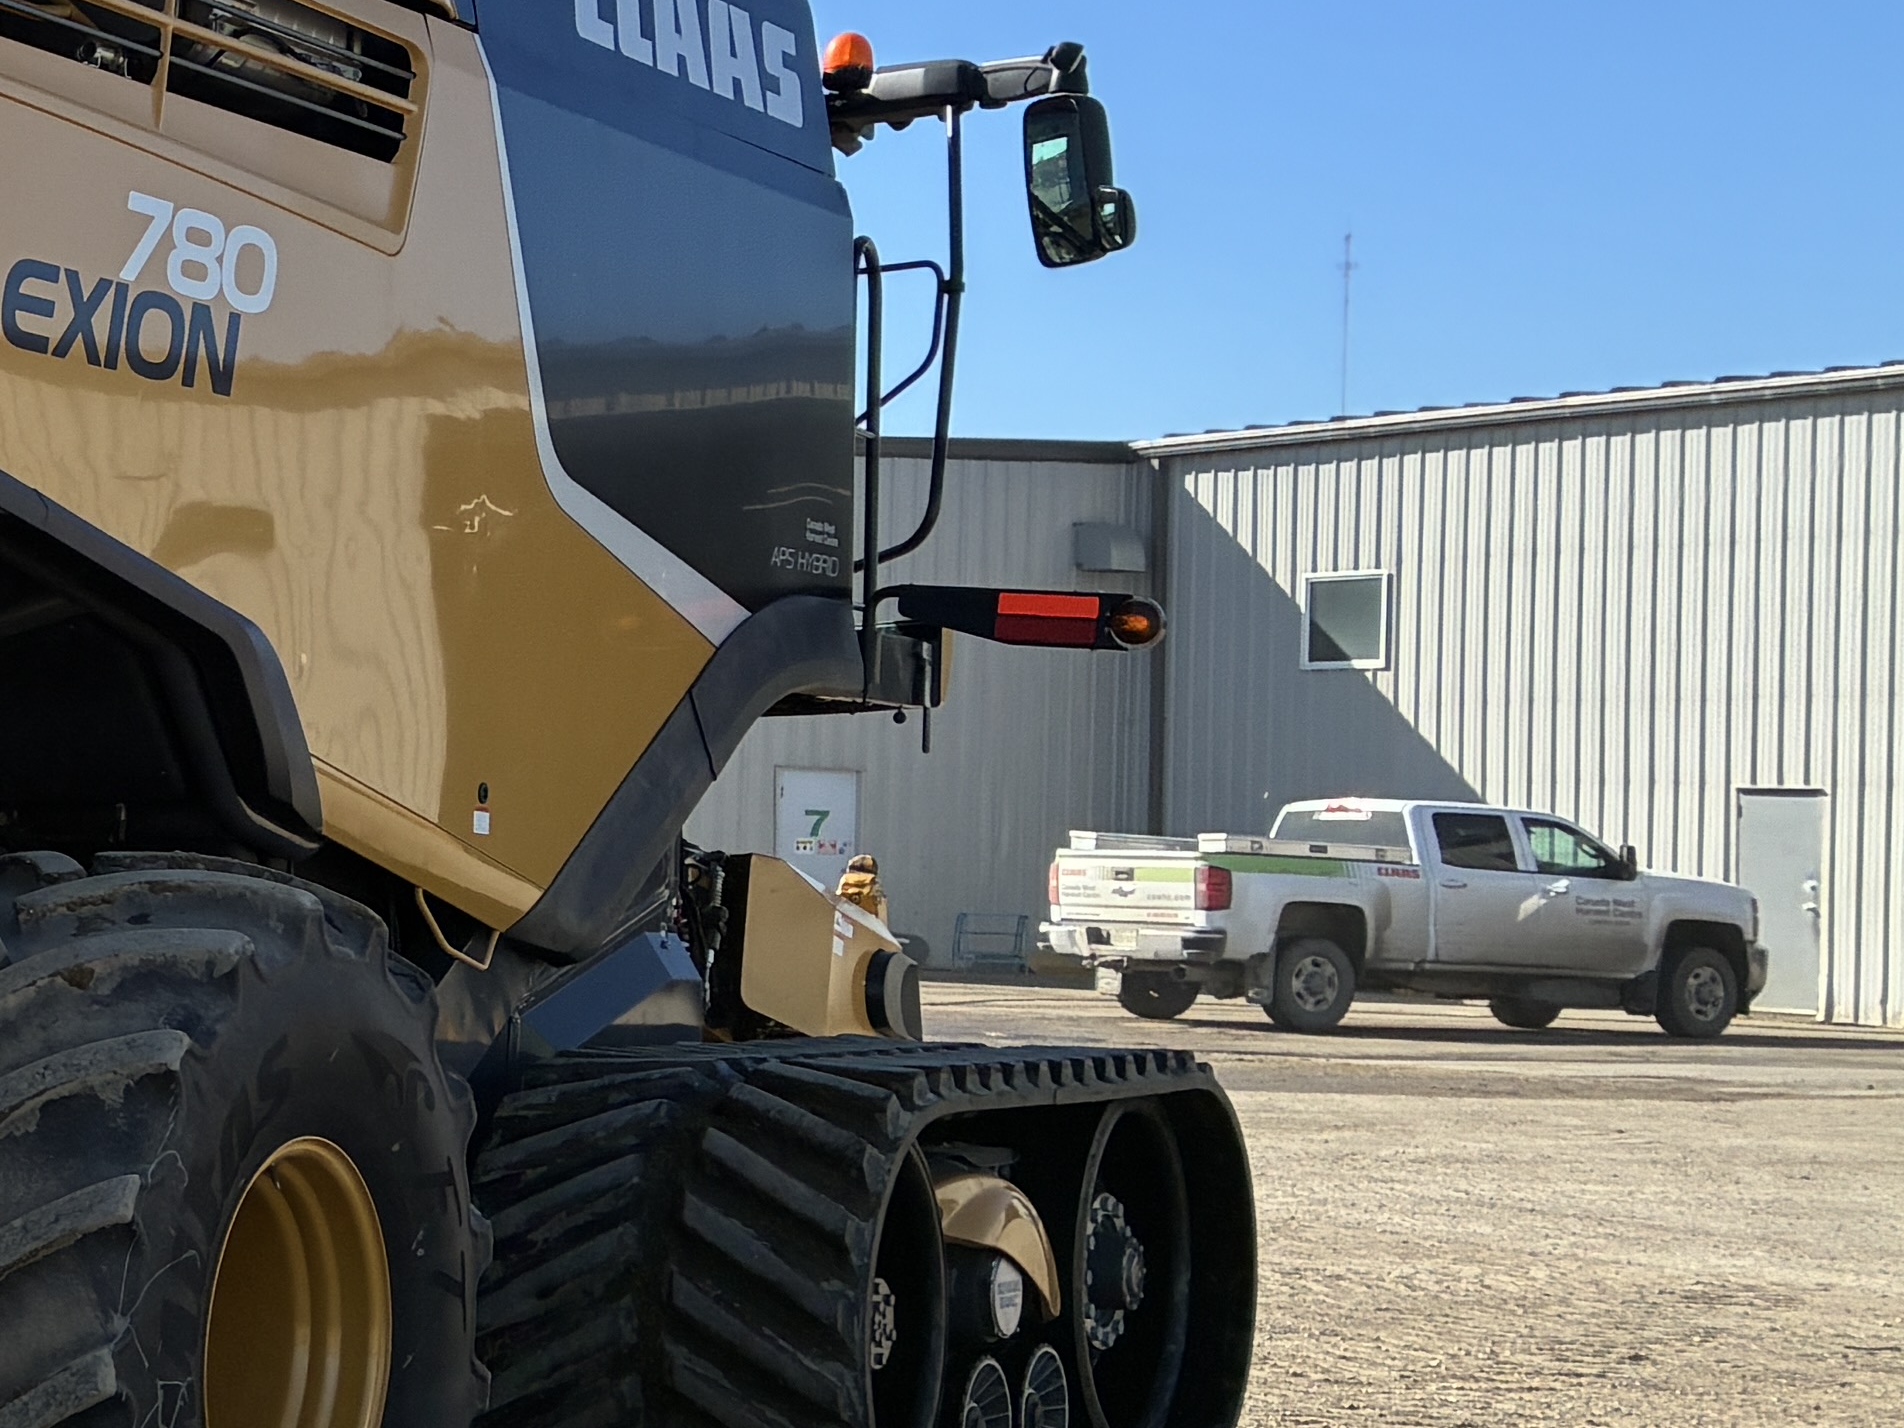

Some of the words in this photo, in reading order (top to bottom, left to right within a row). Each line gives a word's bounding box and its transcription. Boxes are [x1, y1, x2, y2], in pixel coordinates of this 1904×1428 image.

[118, 189, 279, 315] 780
[771, 546, 796, 570] APS
[796, 551, 840, 578] HYBRID
[804, 809, 830, 838] 7
